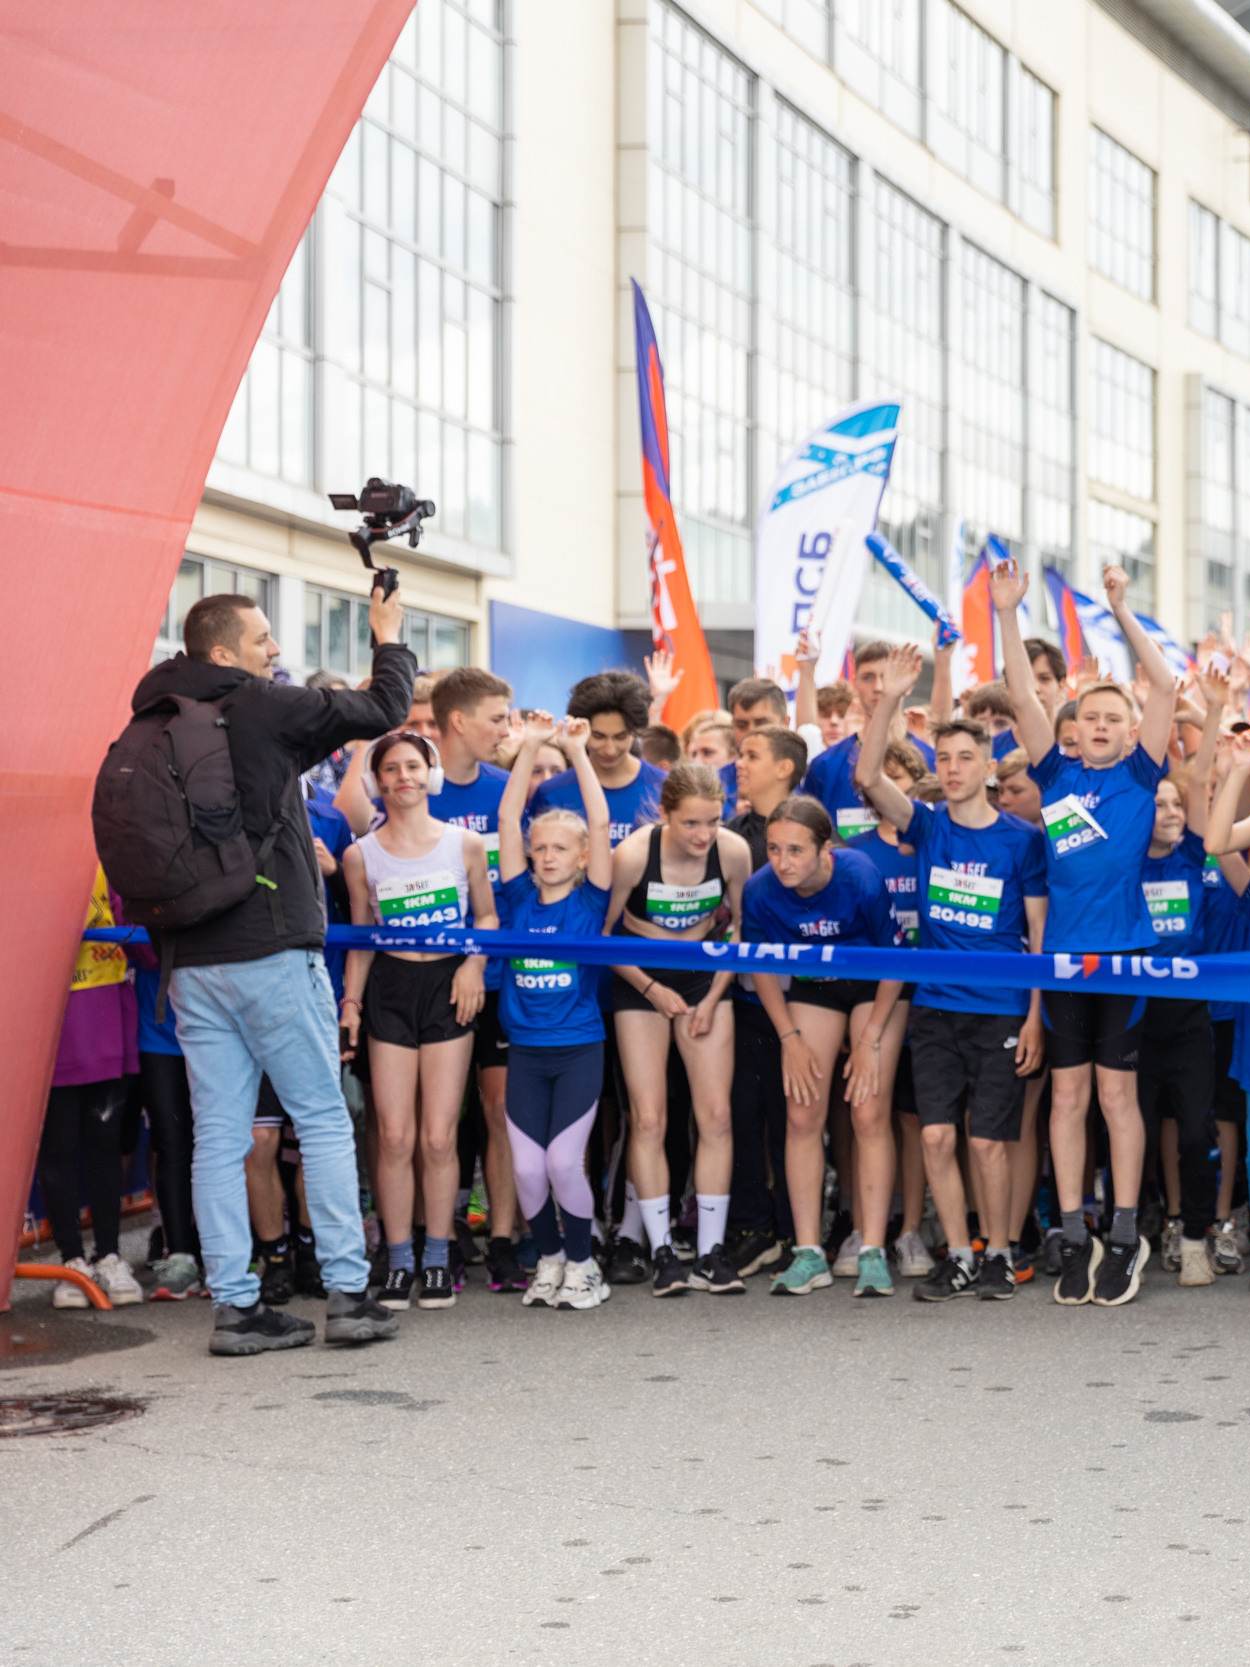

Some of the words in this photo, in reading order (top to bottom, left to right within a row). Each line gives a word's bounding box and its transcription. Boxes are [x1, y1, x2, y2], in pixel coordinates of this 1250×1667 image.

[799, 916, 841, 937] ЗАБЕГ
[928, 904, 994, 930] 20492
[1151, 917, 1187, 933] 013
[514, 972, 573, 990] 20179
